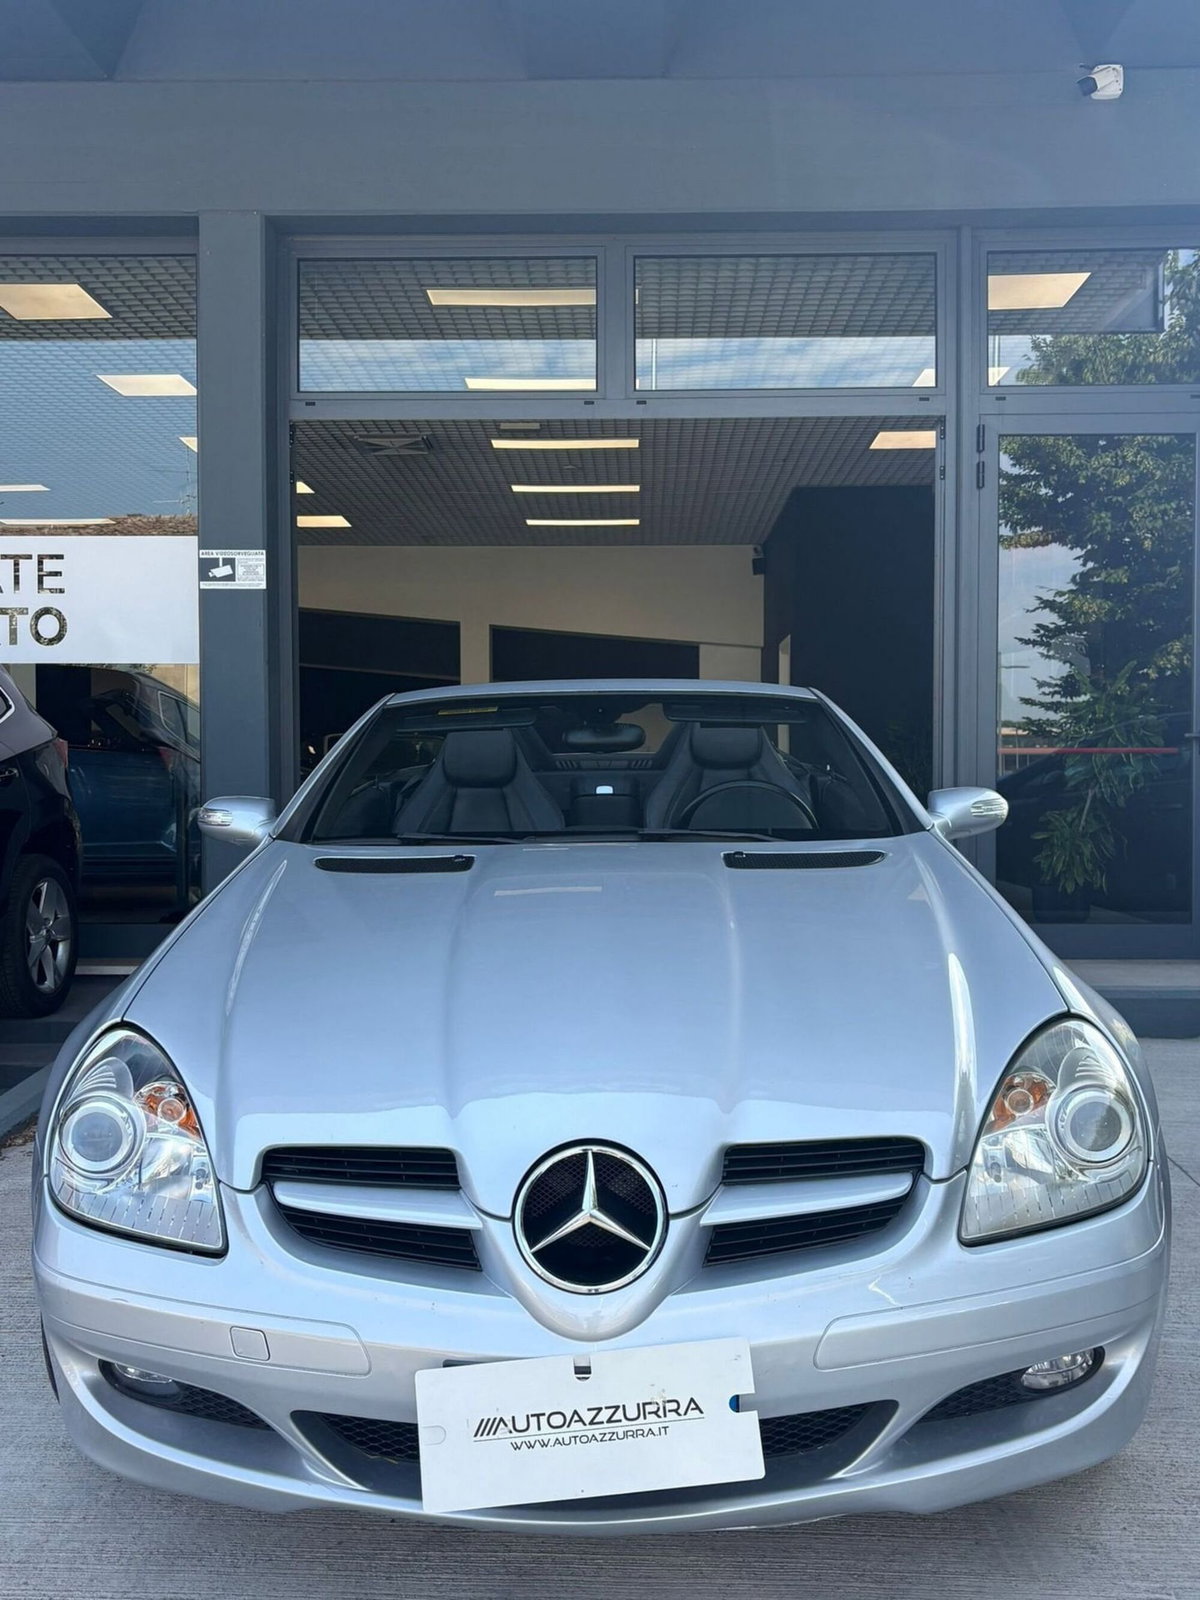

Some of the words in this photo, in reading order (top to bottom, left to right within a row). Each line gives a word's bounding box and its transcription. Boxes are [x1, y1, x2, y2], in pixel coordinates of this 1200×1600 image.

[0, 554, 65, 594] TE
[0, 606, 68, 646] TO
[510, 1425, 670, 1451] WWW.AUTOAZZURRA.IT
